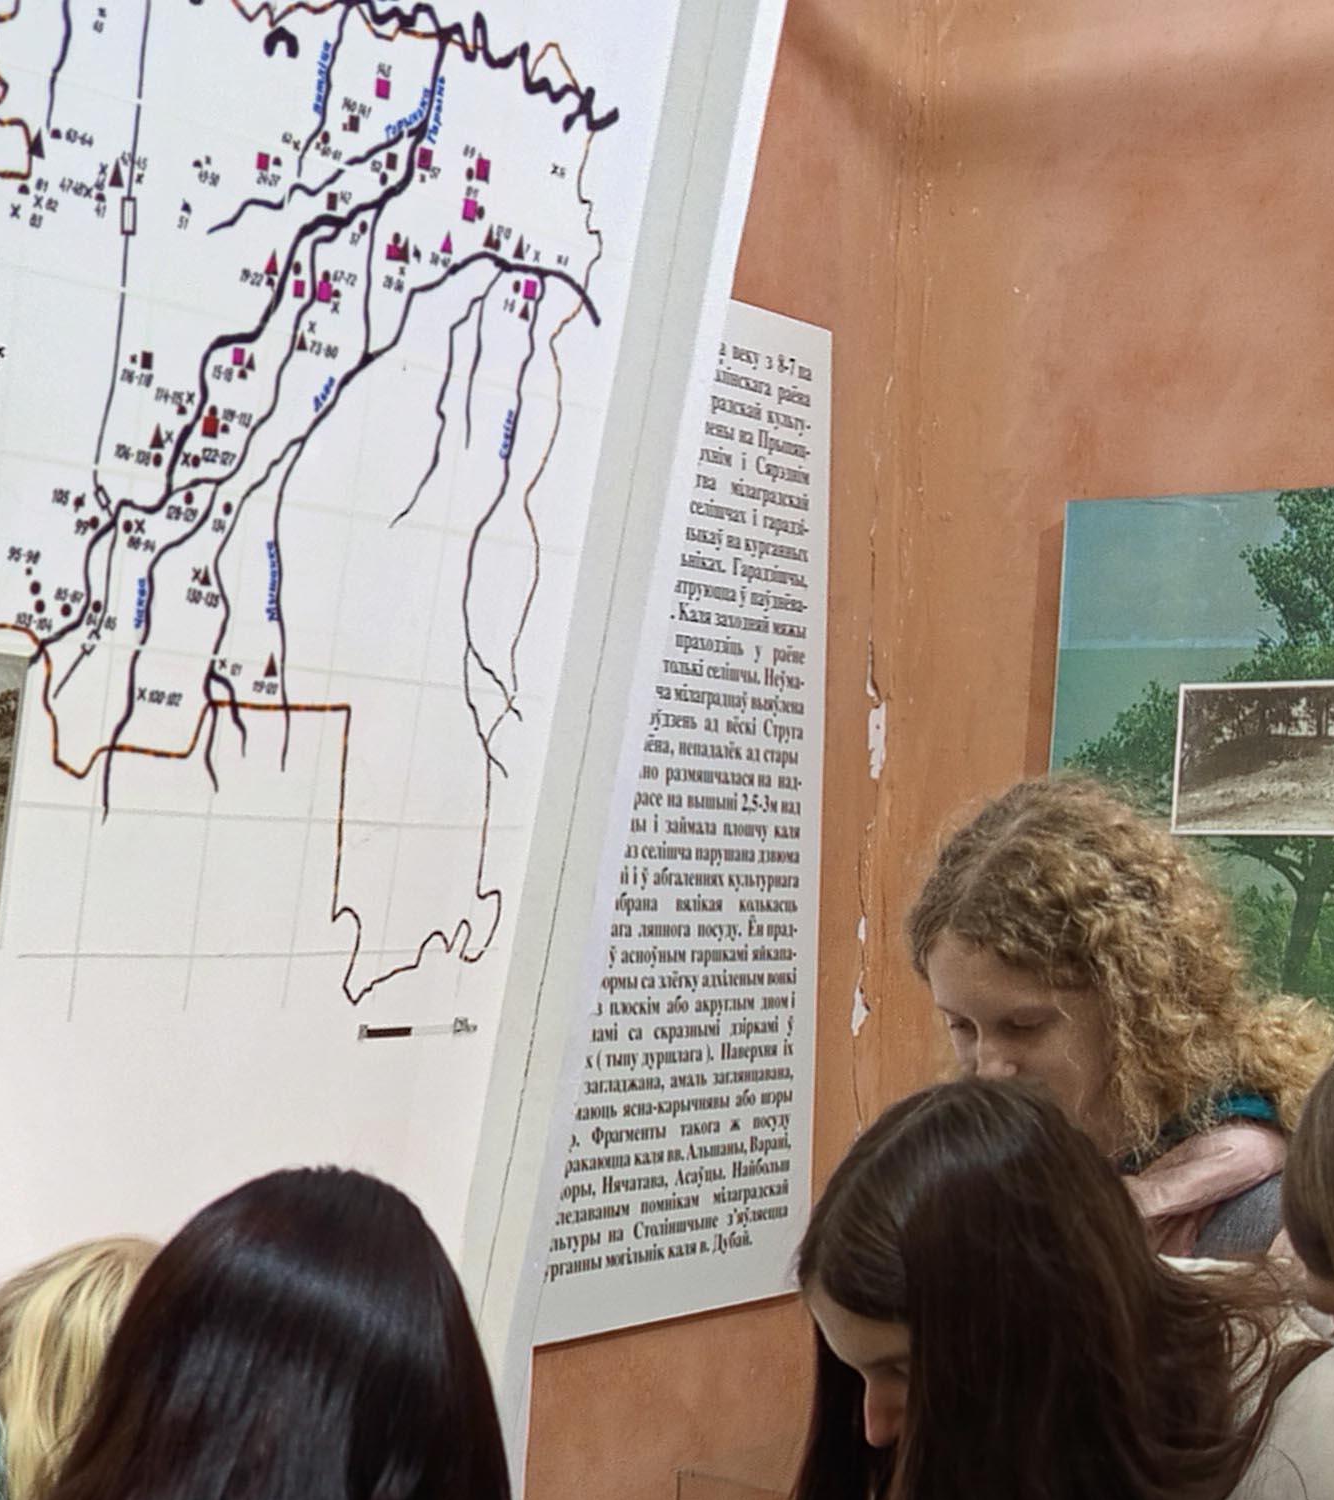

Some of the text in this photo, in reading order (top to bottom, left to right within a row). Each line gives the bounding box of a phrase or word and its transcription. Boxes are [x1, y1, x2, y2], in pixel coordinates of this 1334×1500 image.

[679, 602, 711, 624] Каля
[754, 645, 762, 663] у
[773, 645, 806, 666] раёне
[726, 715, 756, 735] вёскі
[763, 718, 804, 743] Струга
[679, 741, 742, 760] непадалёк
[746, 750, 760, 763] ад
[665, 766, 755, 786] размяшчалася
[758, 773, 772, 788] на
[667, 792, 683, 808] на
[687, 792, 737, 811] вышыні
[781, 801, 801, 816] над
[665, 816, 716, 836] займала
[723, 822, 769, 843] плошчу
[774, 826, 801, 839] каля
[641, 841, 692, 861] селішча
[695, 846, 755, 866] парушана
[728, 874, 800, 892] культурнага
[676, 893, 723, 912] вялікая
[739, 898, 798, 914] колькасць
[697, 923, 742, 942] посуду.
[748, 915, 764, 937] Ён
[621, 946, 686, 968] асноўным
[691, 944, 748, 968] гаршкамі
[641, 976, 655, 989] са
[702, 969, 765, 988] адхіленым
[768, 967, 797, 986] вонкі
[609, 996, 660, 1016] плоскім
[667, 995, 689, 1014] або
[695, 995, 755, 1018] акруглым
[628, 1016, 779, 1044] са скразнымі дзіркамі
[721, 1042, 778, 1063] Паверхня
[783, 1038, 794, 1056] іх
[584, 1076, 665, 1095] загладжана,
[670, 1073, 707, 1088] амаль
[735, 1091, 756, 1107] або
[591, 1112, 791, 1149] Фрагменты такога ж посуду
[633, 1152, 665, 1167] каля
[686, 1141, 748, 1161] Альшаны,
[560, 1158, 790, 1204] оры, Нячатава, Асаўцы. Найбольш
[640, 1193, 700, 1215] помнікам
[608, 1228, 624, 1243] на
[633, 1215, 720, 1240] Століншчыне
[605, 1244, 665, 1269] могільнік
[667, 1241, 697, 1261] каля
[711, 1230, 754, 1254] Дубай.
